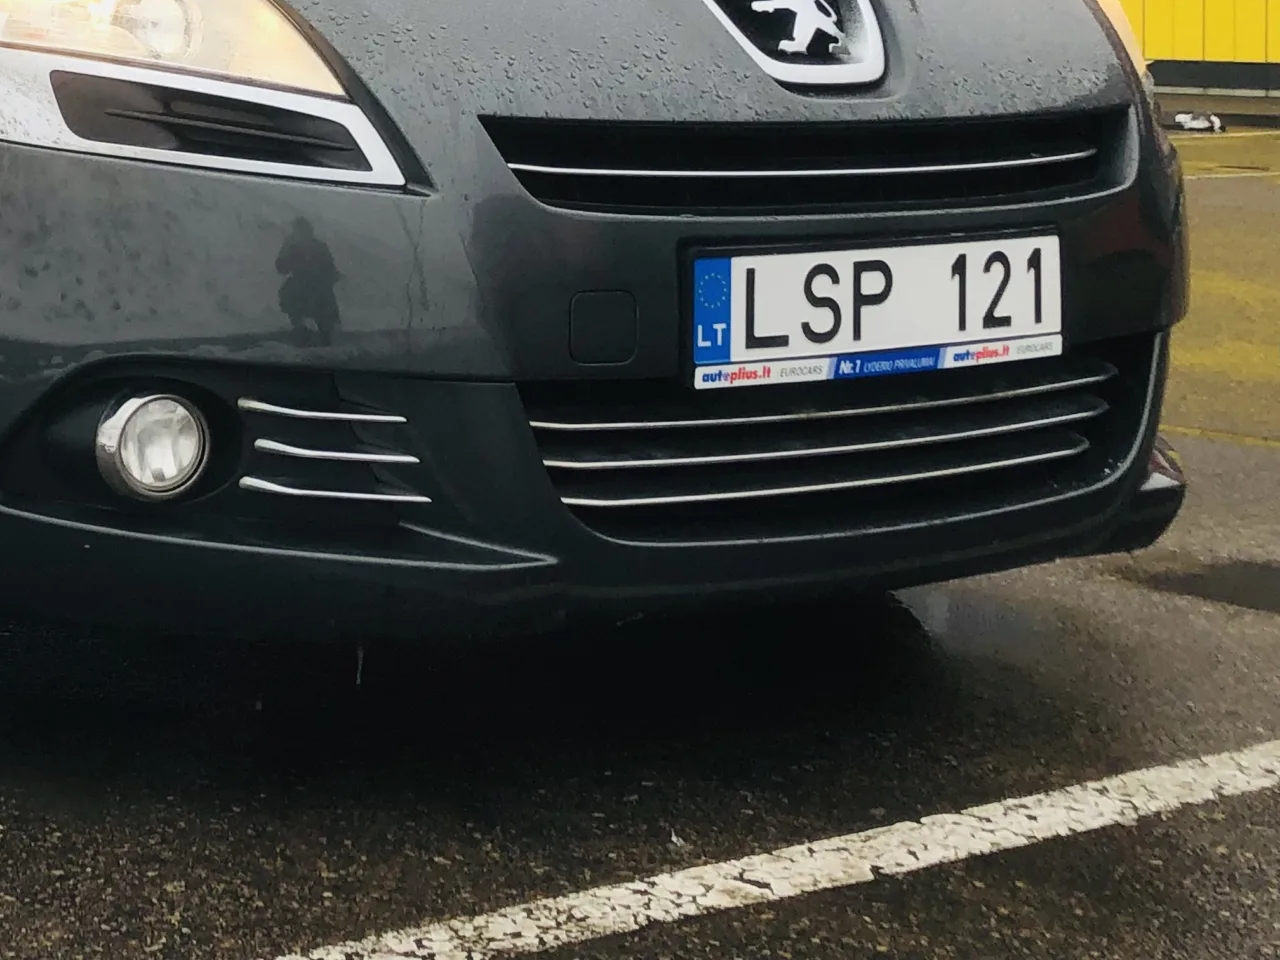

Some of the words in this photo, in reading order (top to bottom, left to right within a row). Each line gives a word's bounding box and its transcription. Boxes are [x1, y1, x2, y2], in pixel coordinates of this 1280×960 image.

[745, 259, 893, 350] LSP
[951, 247, 1042, 332] 121
[697, 322, 728, 349] LT
[779, 365, 824, 378] EUROCARS
